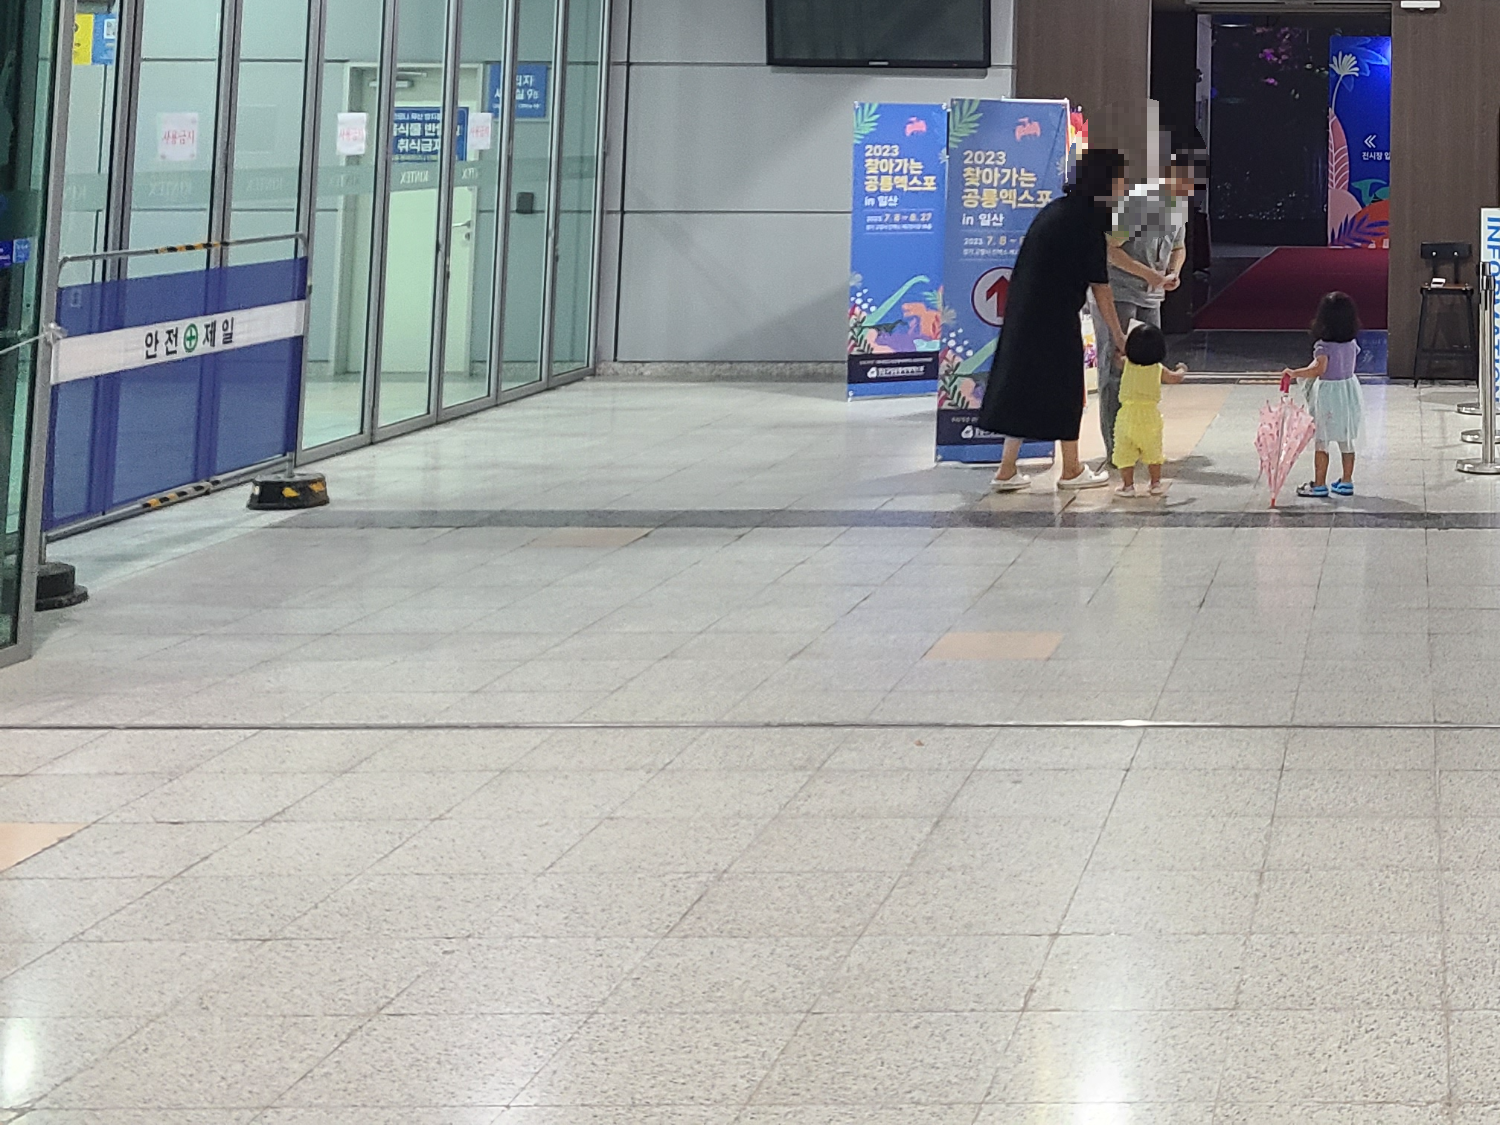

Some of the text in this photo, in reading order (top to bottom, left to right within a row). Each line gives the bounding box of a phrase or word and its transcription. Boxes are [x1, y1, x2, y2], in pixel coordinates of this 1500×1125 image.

[864, 145, 900, 157] 2023
[963, 150, 1007, 165] 2023
[864, 158, 924, 175] 찾아가는
[864, 175, 937, 192] 공룡엑스포
[963, 167, 1037, 188] 찾아가는
[864, 195, 899, 207] in 일산
[962, 188, 1053, 209] 공룡엑스포
[962, 213, 1005, 227] in 일산
